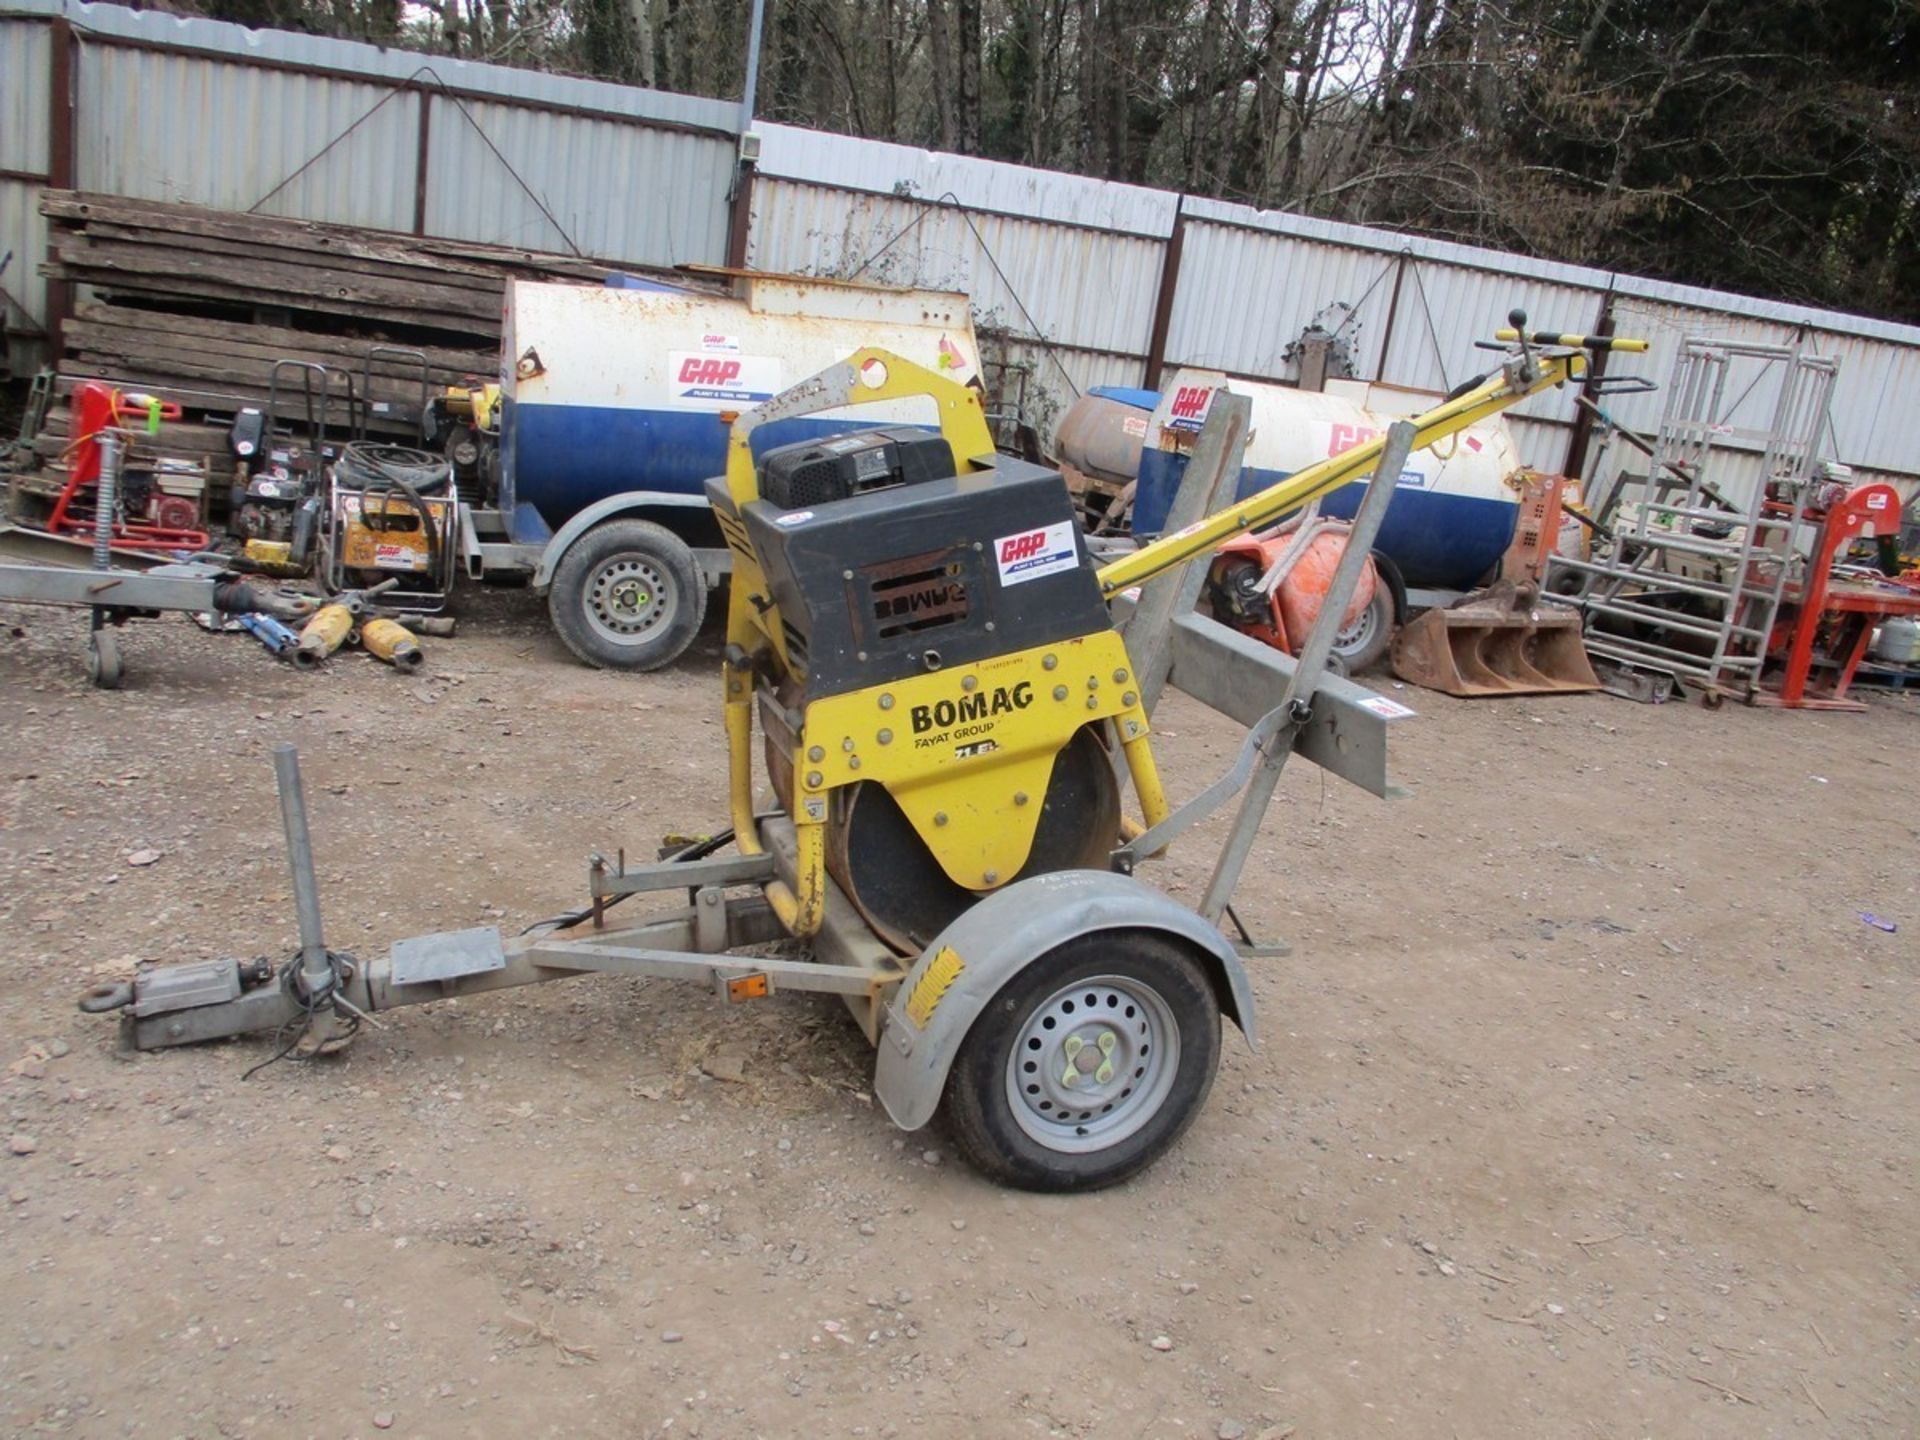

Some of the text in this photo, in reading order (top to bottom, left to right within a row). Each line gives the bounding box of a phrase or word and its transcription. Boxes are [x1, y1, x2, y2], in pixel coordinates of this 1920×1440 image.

[678, 358, 741, 386] GAP
[1170, 387, 1210, 417] GAP
[1000, 532, 1046, 564] GAP
[910, 681, 1034, 734] BOMAG
[914, 723, 994, 749] FAYAT GROUP
